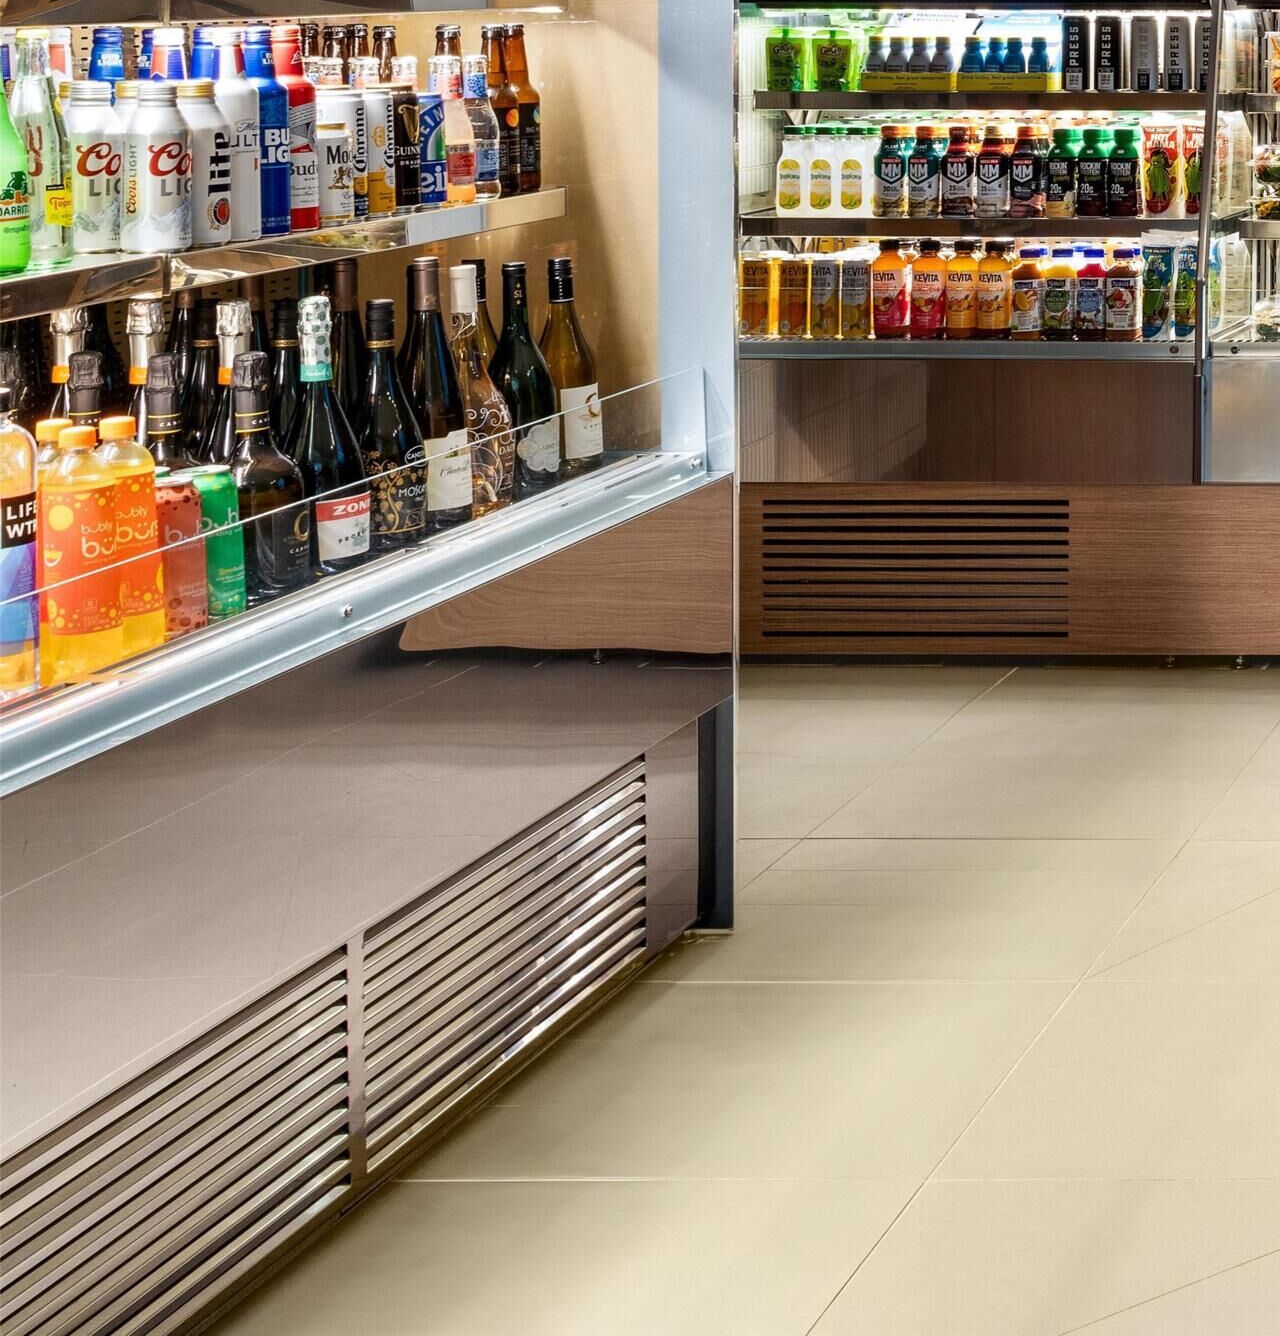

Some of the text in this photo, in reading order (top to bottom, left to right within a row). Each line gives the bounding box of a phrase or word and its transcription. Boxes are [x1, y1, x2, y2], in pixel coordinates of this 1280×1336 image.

[1069, 26, 1079, 66] PRESS
[1101, 26, 1111, 66] PRESS
[1170, 26, 1180, 66] PRESS
[913, 273, 939, 283] KEVITA
[948, 273, 973, 283] KEVITA
